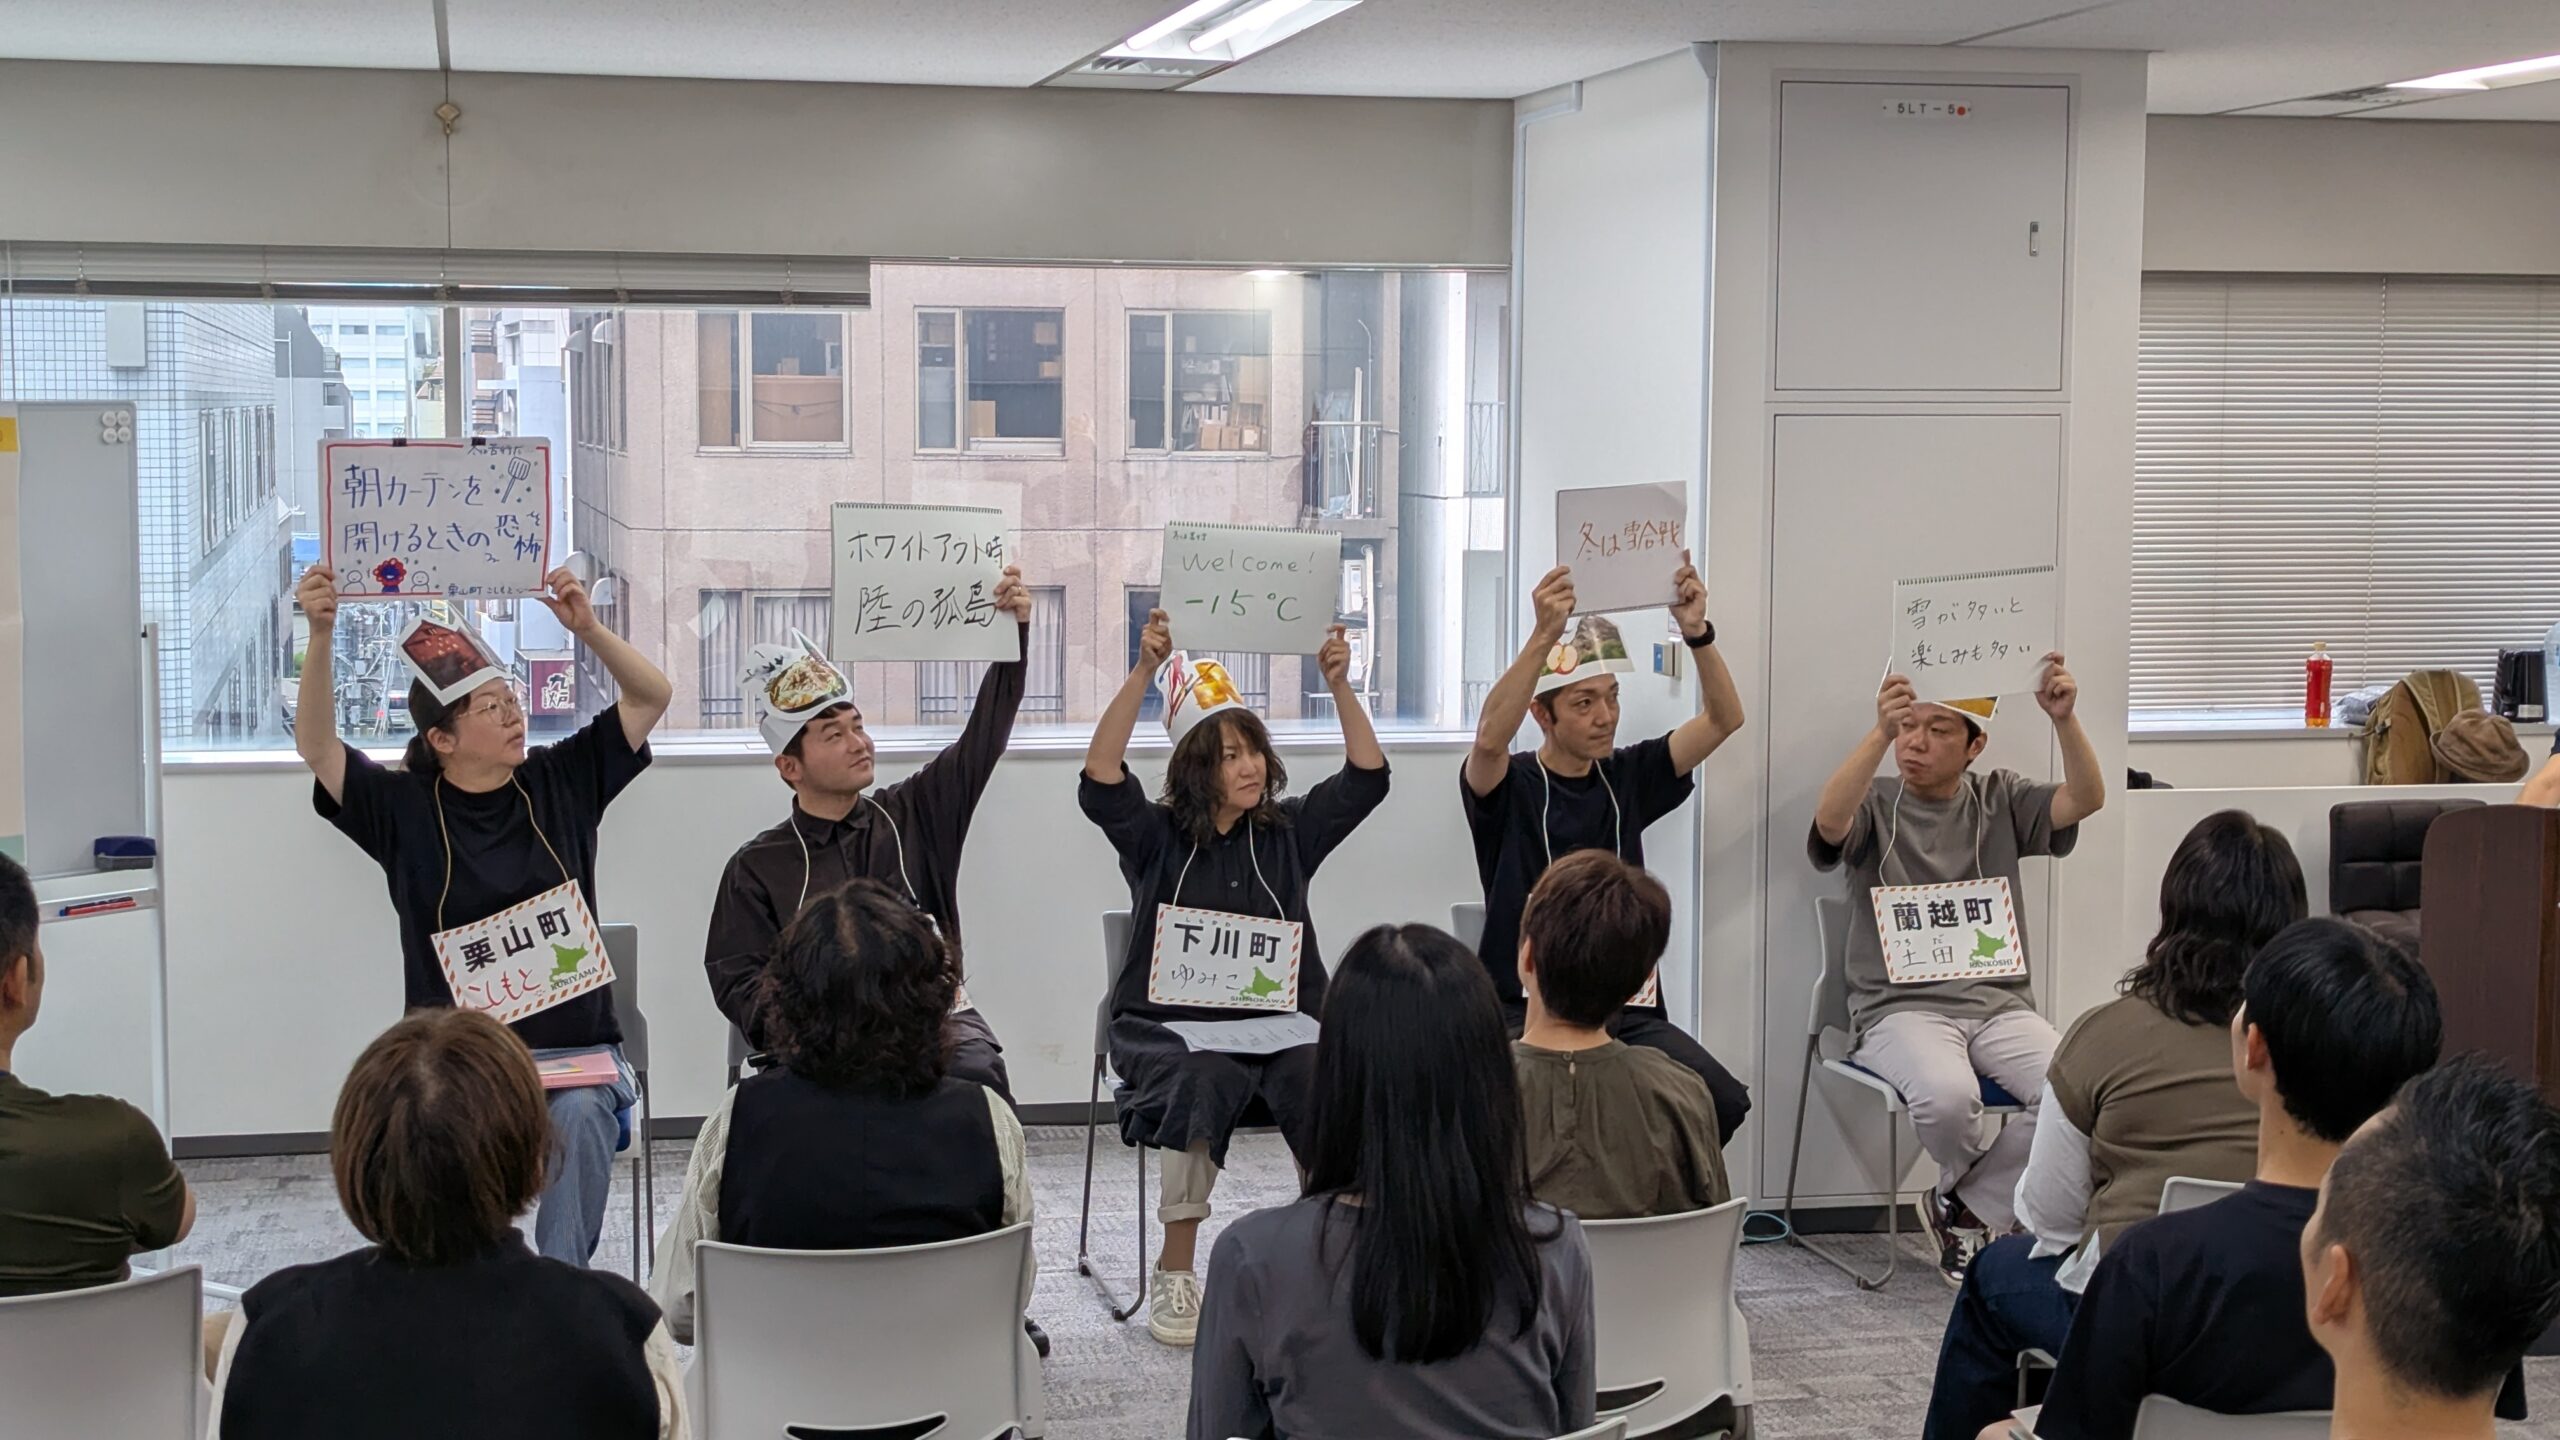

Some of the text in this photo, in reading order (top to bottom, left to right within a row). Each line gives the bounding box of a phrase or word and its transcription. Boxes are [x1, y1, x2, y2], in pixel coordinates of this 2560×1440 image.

[342, 464, 483, 509] 朝カーテンを
[848, 530, 1003, 569] ホワイトアウト時
[1576, 519, 1681, 561] 冬は雪合戦
[855, 580, 998, 635] 陸の孤島
[1907, 597, 2024, 630] 雪が多いと
[1911, 640, 2031, 671] 楽しみも多い
[1891, 897, 1994, 932] 蘭越町
[460, 906, 572, 973] 栗山町
[1174, 922, 1282, 964] 下川町
[1902, 945, 1953, 969] 土田
[550, 966, 598, 991] KURIYAMA
[1172, 963, 1241, 990] ゆみこ
